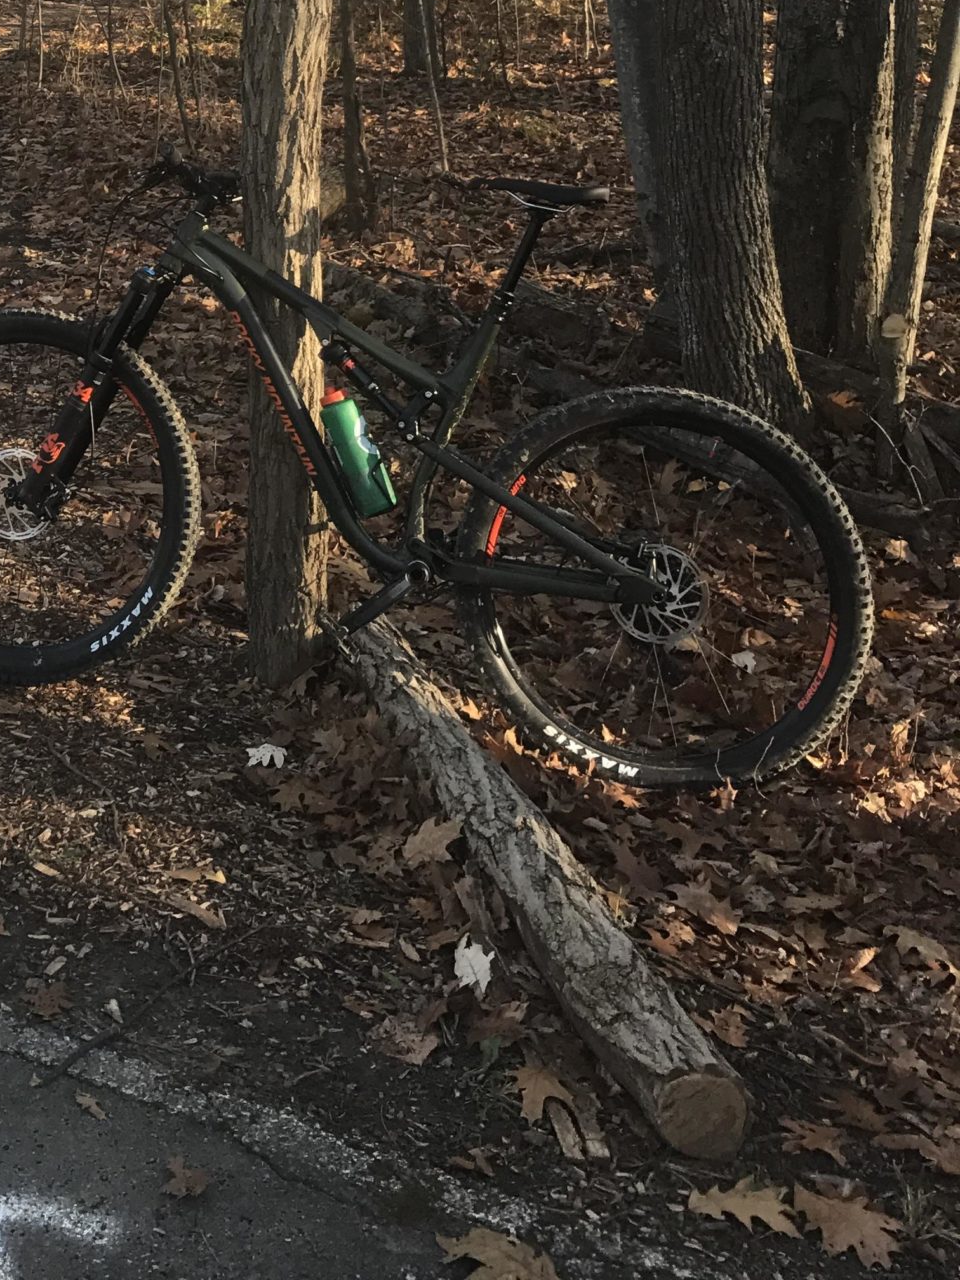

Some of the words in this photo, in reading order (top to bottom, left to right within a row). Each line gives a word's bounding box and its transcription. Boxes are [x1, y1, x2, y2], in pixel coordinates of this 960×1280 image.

[72, 380, 94, 404] 34
[231, 311, 266, 371] ROCKY
[260, 375, 318, 476] MOUNTAIN
[90, 586, 153, 653] MAXXIS
[543, 725, 640, 778] MAXXIS
